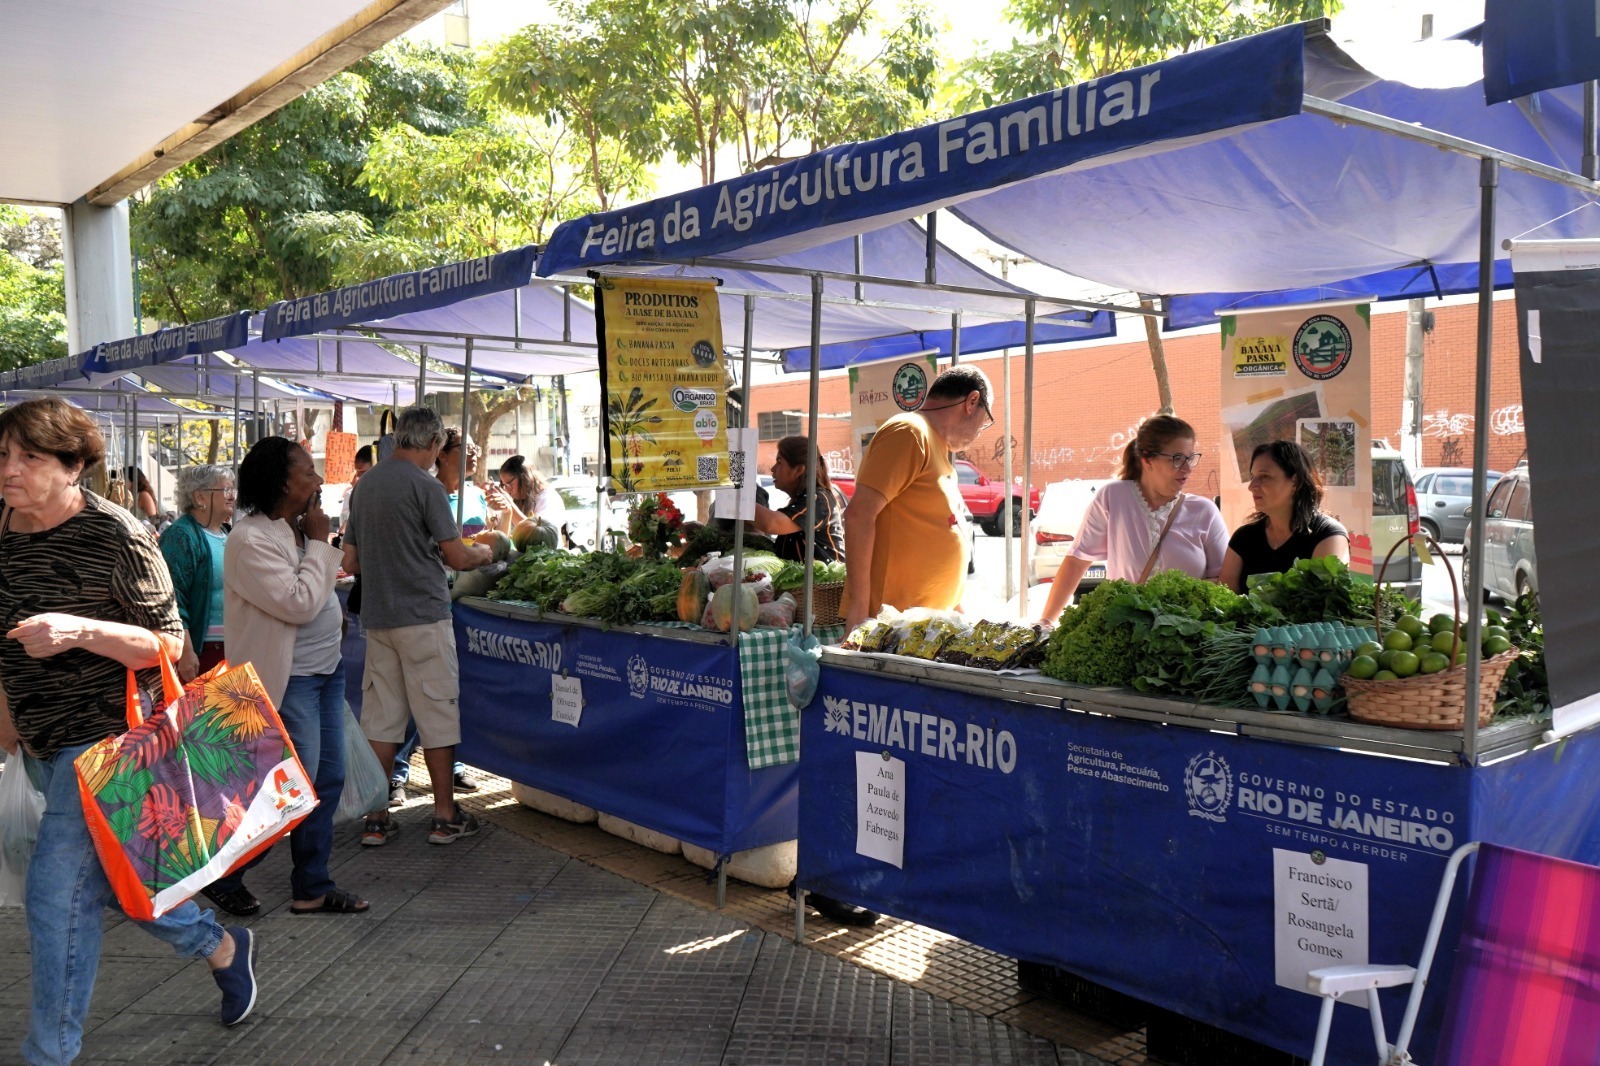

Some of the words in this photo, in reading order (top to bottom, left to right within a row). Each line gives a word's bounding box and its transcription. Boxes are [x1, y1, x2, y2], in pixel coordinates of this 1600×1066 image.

[580, 216, 655, 259] Feira
[663, 201, 700, 244] da
[711, 141, 925, 231] Agricultura
[938, 69, 1161, 172] Familiar
[277, 300, 310, 325] Feira
[313, 294, 330, 315] da
[333, 275, 416, 318] Agricultura
[419, 256, 495, 296] Familiar
[624, 291, 699, 308] PRODUTOS
[626, 308, 632, 316] A
[633, 308, 653, 317] BASE
[654, 309, 665, 317] DE
[666, 309, 699, 319] BANANA
[94, 344, 119, 363] Feira
[121, 341, 132, 360] da
[628, 340, 655, 349] BANANA
[655, 340, 675, 349] PASSA
[1240, 344, 1281, 354] BANANA
[629, 358, 650, 367] DOCES
[651, 358, 690, 367] ARTESANAIS
[1242, 364, 1279, 372] ORGÂNICA
[1246, 353, 1276, 363] PASSA
[673, 373, 699, 382] BANANA
[700, 373, 719, 382] VERDE
[479, 632, 562, 672] EMATER-RIO
[650, 666, 685, 680] GOVERNO
[685, 672, 695, 681] DO
[698, 675, 733, 688] ESTADO
[650, 675, 668, 692] RIO
[668, 679, 679, 695] DE
[681, 682, 733, 704] JANEIRO
[656, 696, 666, 704] SEM
[666, 698, 689, 708] TEMPO
[694, 702, 716, 713] PERDER
[852, 701, 1017, 774] EMATER-RIO
[1067, 742, 1110, 758] Secretaria
[1111, 749, 1123, 760] de
[877, 766, 894, 780] Ana
[1067, 752, 1119, 772] Agricultura,
[1120, 762, 1161, 780] Pecuária,
[1067, 763, 1094, 777] Pesca
[1094, 769, 1100, 778] e
[1101, 770, 1169, 792] Abastecimento
[867, 783, 890, 800] Paula
[891, 789, 900, 802] de
[1239, 772, 1325, 800] GOVERNO
[1335, 791, 1361, 806] DO
[1372, 798, 1455, 825] ESTADO
[866, 802, 899, 822] Azevedo
[1238, 786, 1283, 816] RIO
[1287, 799, 1323, 825] DE
[1327, 806, 1454, 850] JANEIRO
[865, 821, 899, 842] Fabregas
[1266, 823, 1291, 837] SEM
[1294, 829, 1338, 847] TEMPO
[1341, 841, 1350, 850] A
[1353, 843, 1408, 862] PERDER
[1288, 866, 1353, 891] Francisco
[1301, 892, 1340, 912] Sertã/
[1287, 912, 1354, 938] Rosangela
[1297, 937, 1344, 960] Gomes
